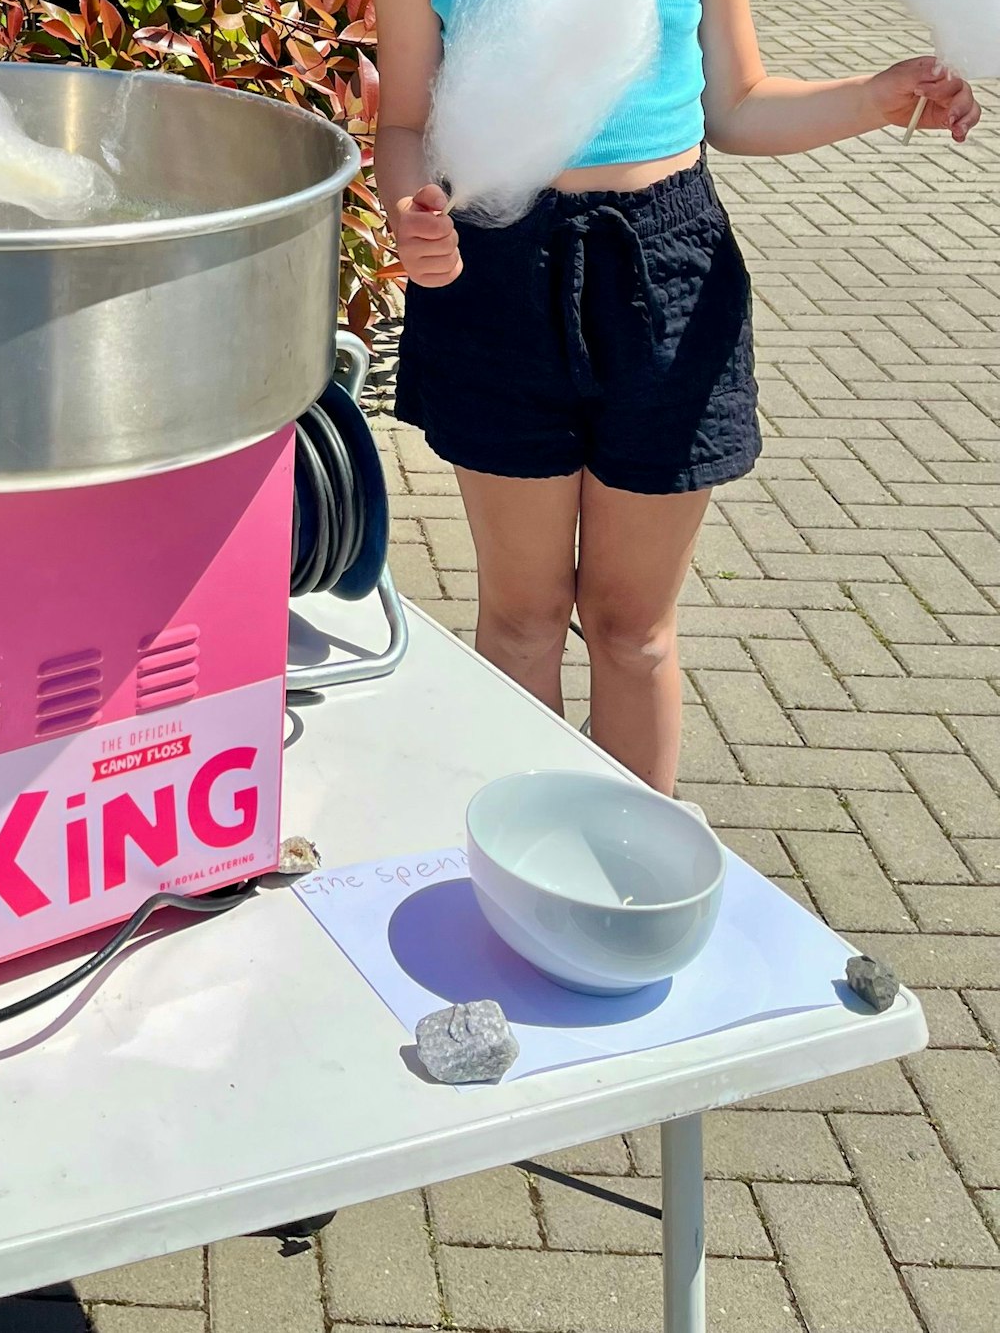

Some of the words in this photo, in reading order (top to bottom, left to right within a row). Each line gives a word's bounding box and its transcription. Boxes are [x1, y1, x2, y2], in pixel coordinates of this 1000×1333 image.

[102, 737, 122, 754] THE
[130, 720, 183, 746] OFFICIAL
[99, 752, 143, 775] CANDY
[146, 740, 184, 763] FLOSS
[159, 881, 171, 891] BY
[175, 870, 206, 886] ROYAL
[208, 853, 255, 875] CATERING
[297, 875, 364, 895] Eine
